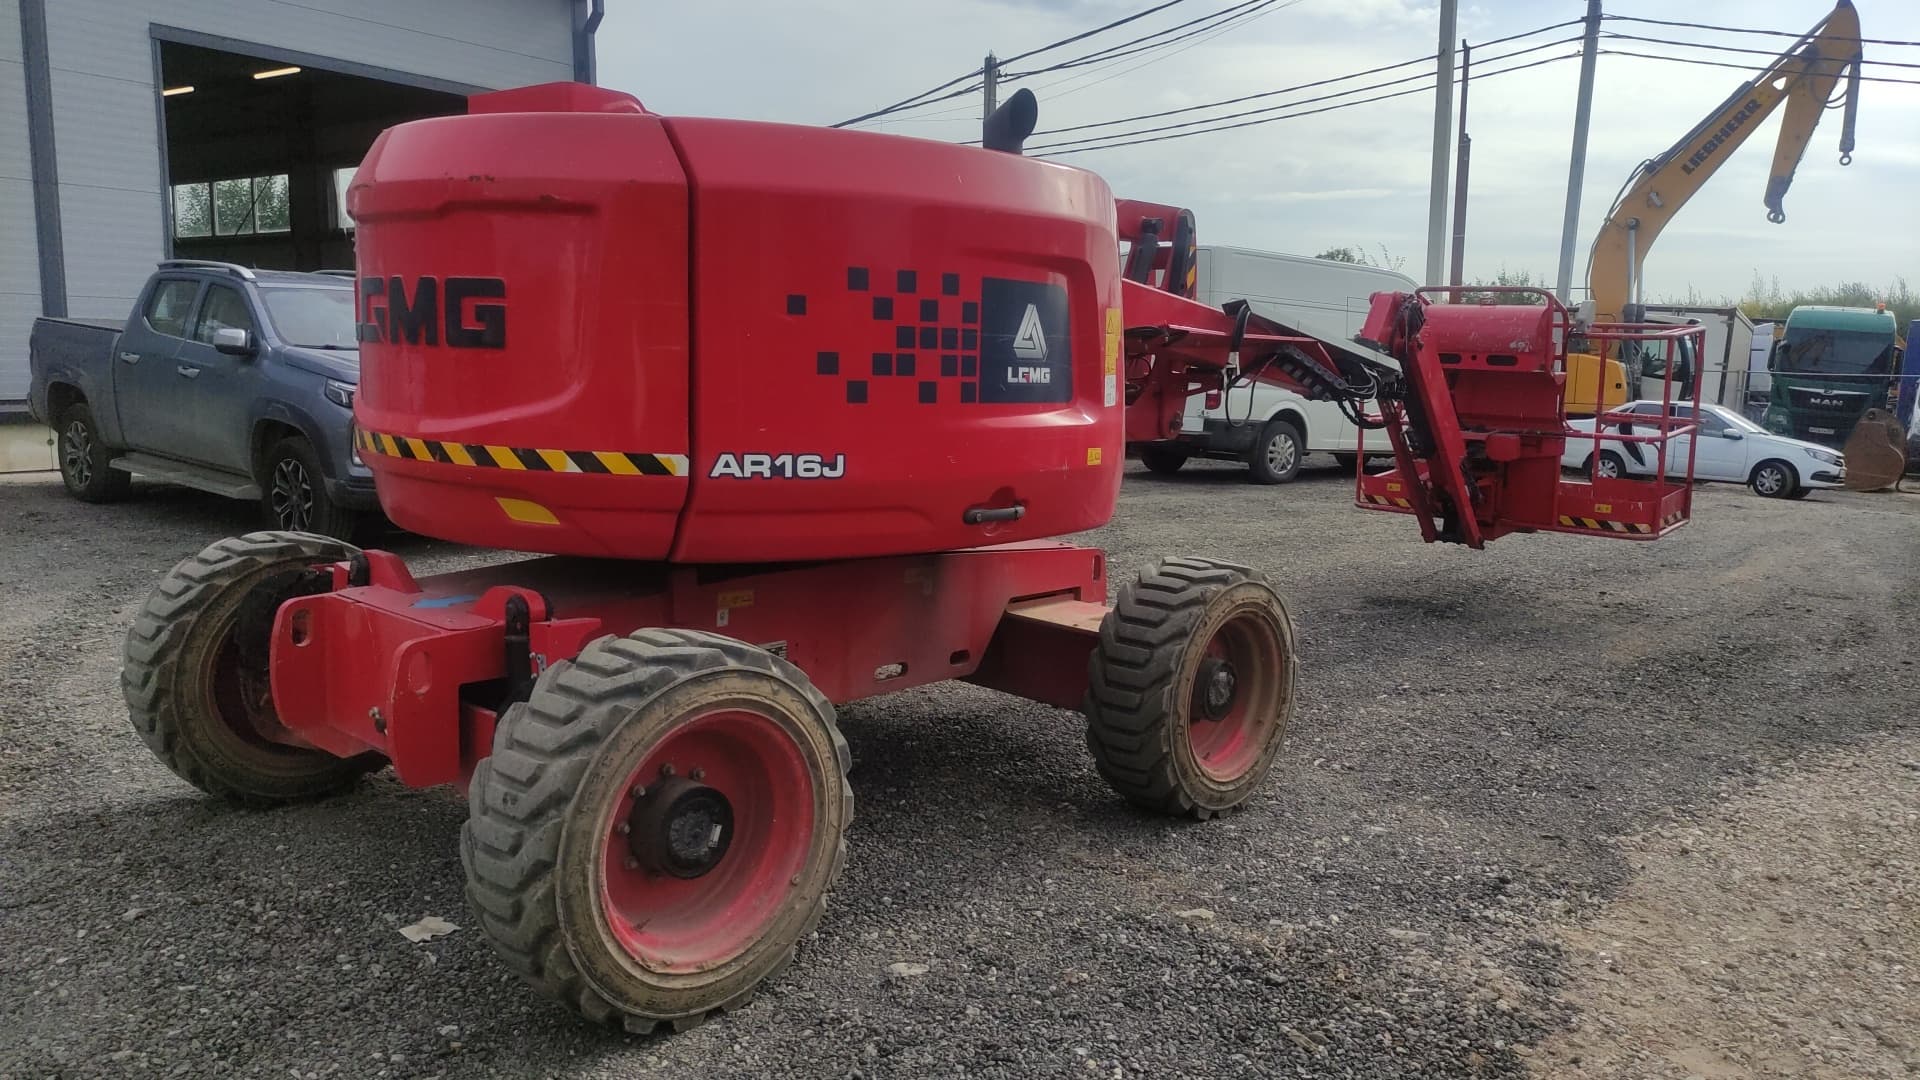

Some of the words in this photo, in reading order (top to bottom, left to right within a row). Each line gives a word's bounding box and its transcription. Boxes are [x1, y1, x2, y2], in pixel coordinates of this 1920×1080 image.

[1681, 99, 1762, 175] LIEBHERR
[1007, 366, 1051, 384] LGMG
[1810, 397, 1844, 407] MAN
[709, 453, 846, 479] AR16J
